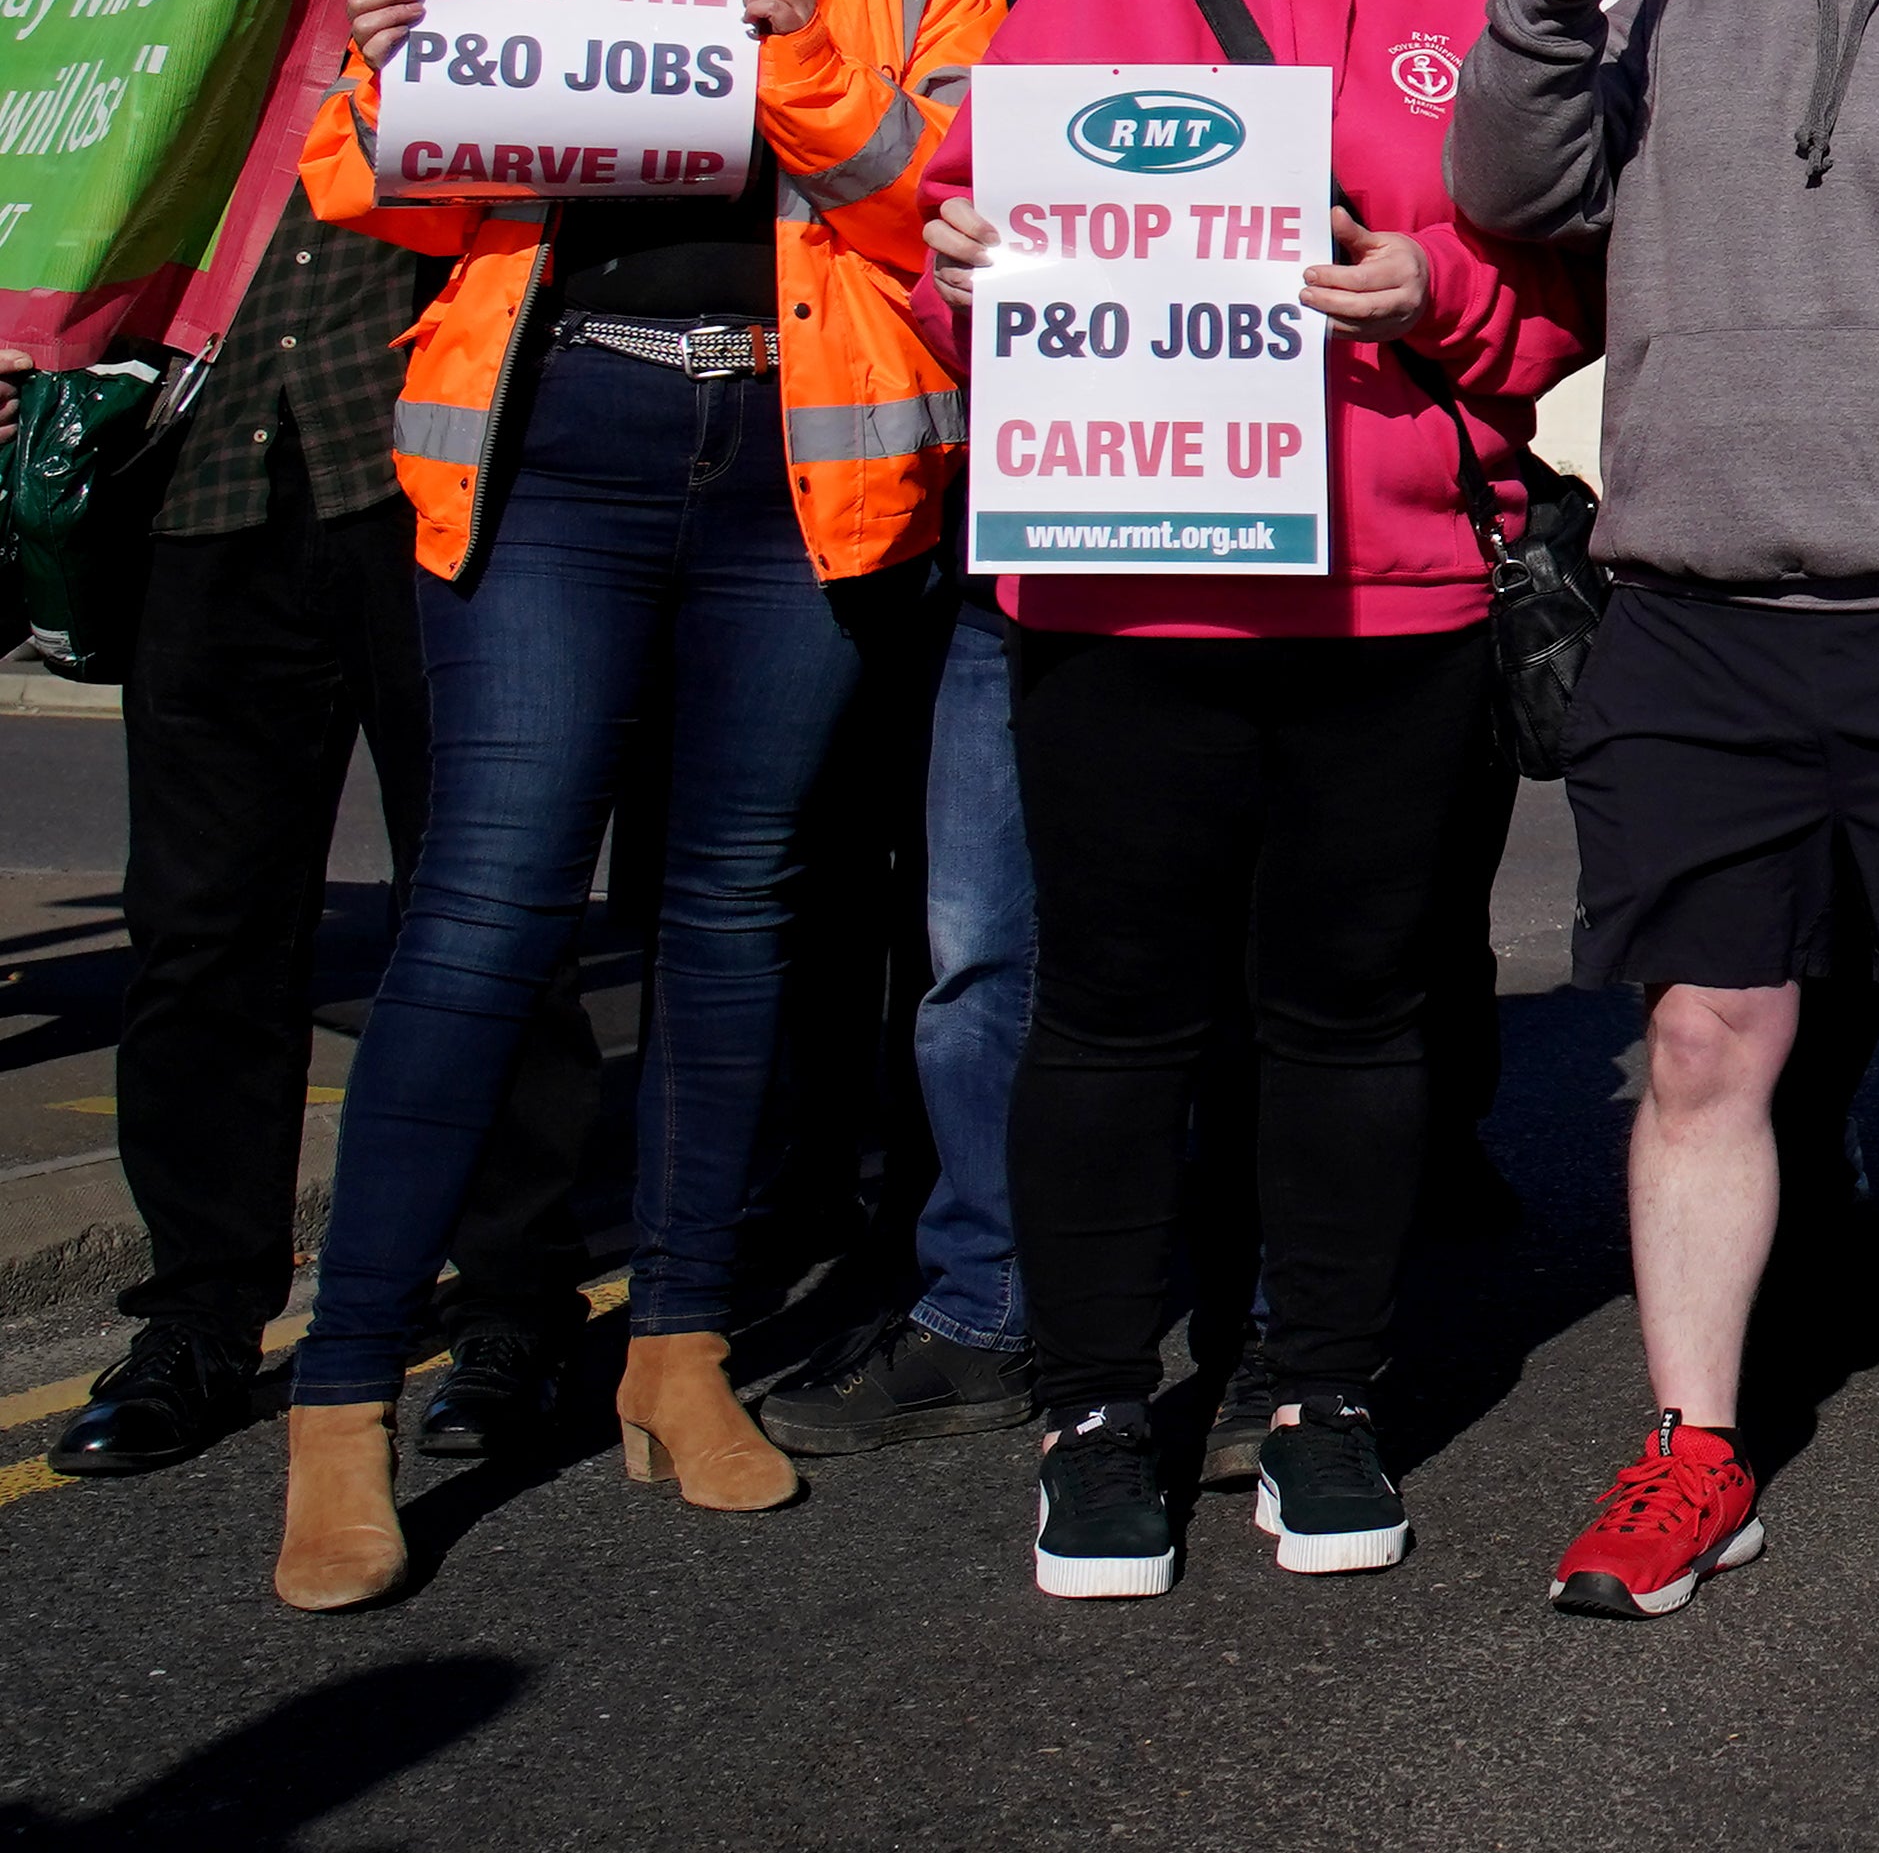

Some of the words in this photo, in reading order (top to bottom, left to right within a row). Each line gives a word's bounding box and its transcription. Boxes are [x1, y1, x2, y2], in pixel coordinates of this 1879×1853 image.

[1388, 42, 1422, 55] DOVER
[1424, 42, 1464, 68] SHIPPIN
[1411, 31, 1450, 45] RMT
[404, 30, 542, 89] P&O
[564, 39, 734, 99] JOBS
[1109, 118, 1213, 147] RMT
[401, 140, 618, 185] CARVE
[640, 149, 725, 186] UP
[1007, 203, 1172, 260] STOP
[1190, 204, 1302, 262] THE
[995, 301, 1131, 360] P&O
[1150, 302, 1304, 361] JOBS
[995, 419, 1204, 478] CARVE
[1226, 421, 1303, 479] UP
[1026, 520, 1276, 556] www.rmt.org.uk
